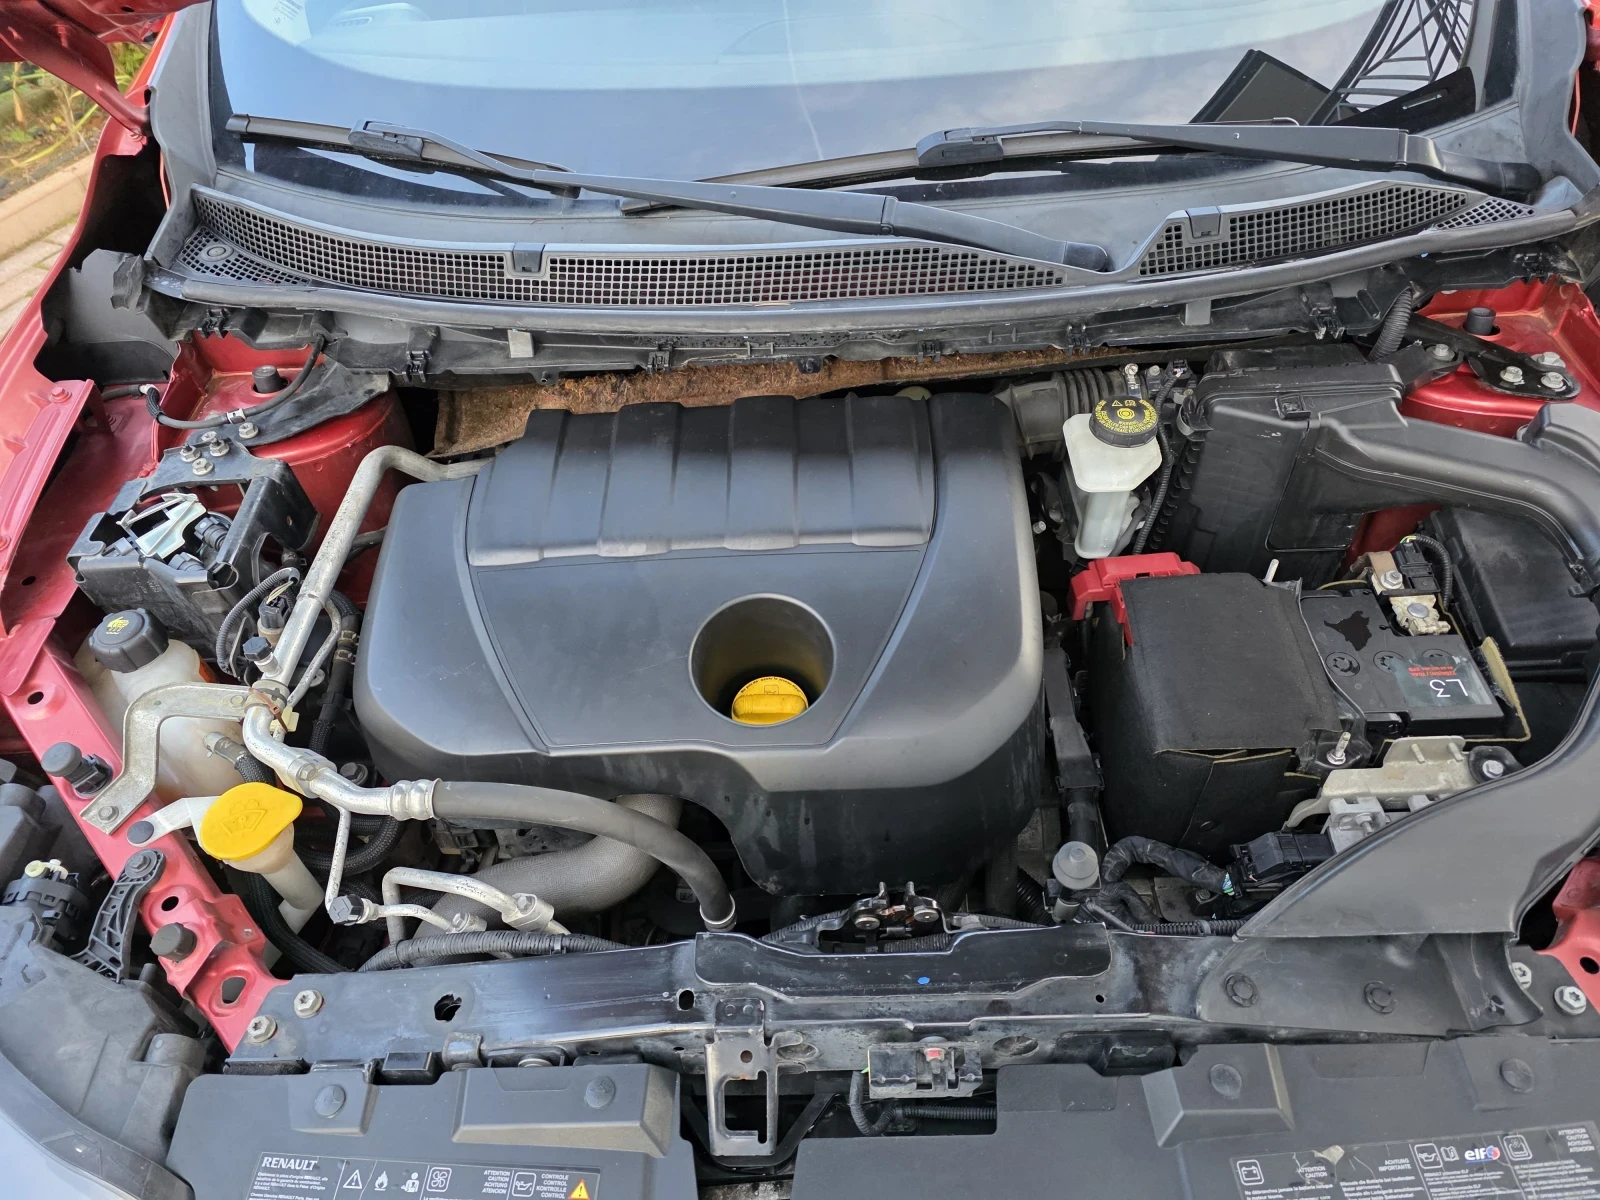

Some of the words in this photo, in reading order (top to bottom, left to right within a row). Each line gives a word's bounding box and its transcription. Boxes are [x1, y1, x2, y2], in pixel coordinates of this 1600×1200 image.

[1429, 679, 1468, 697] L3
[1464, 1148, 1486, 1160] elf
[262, 1156, 318, 1170] RENAULT
